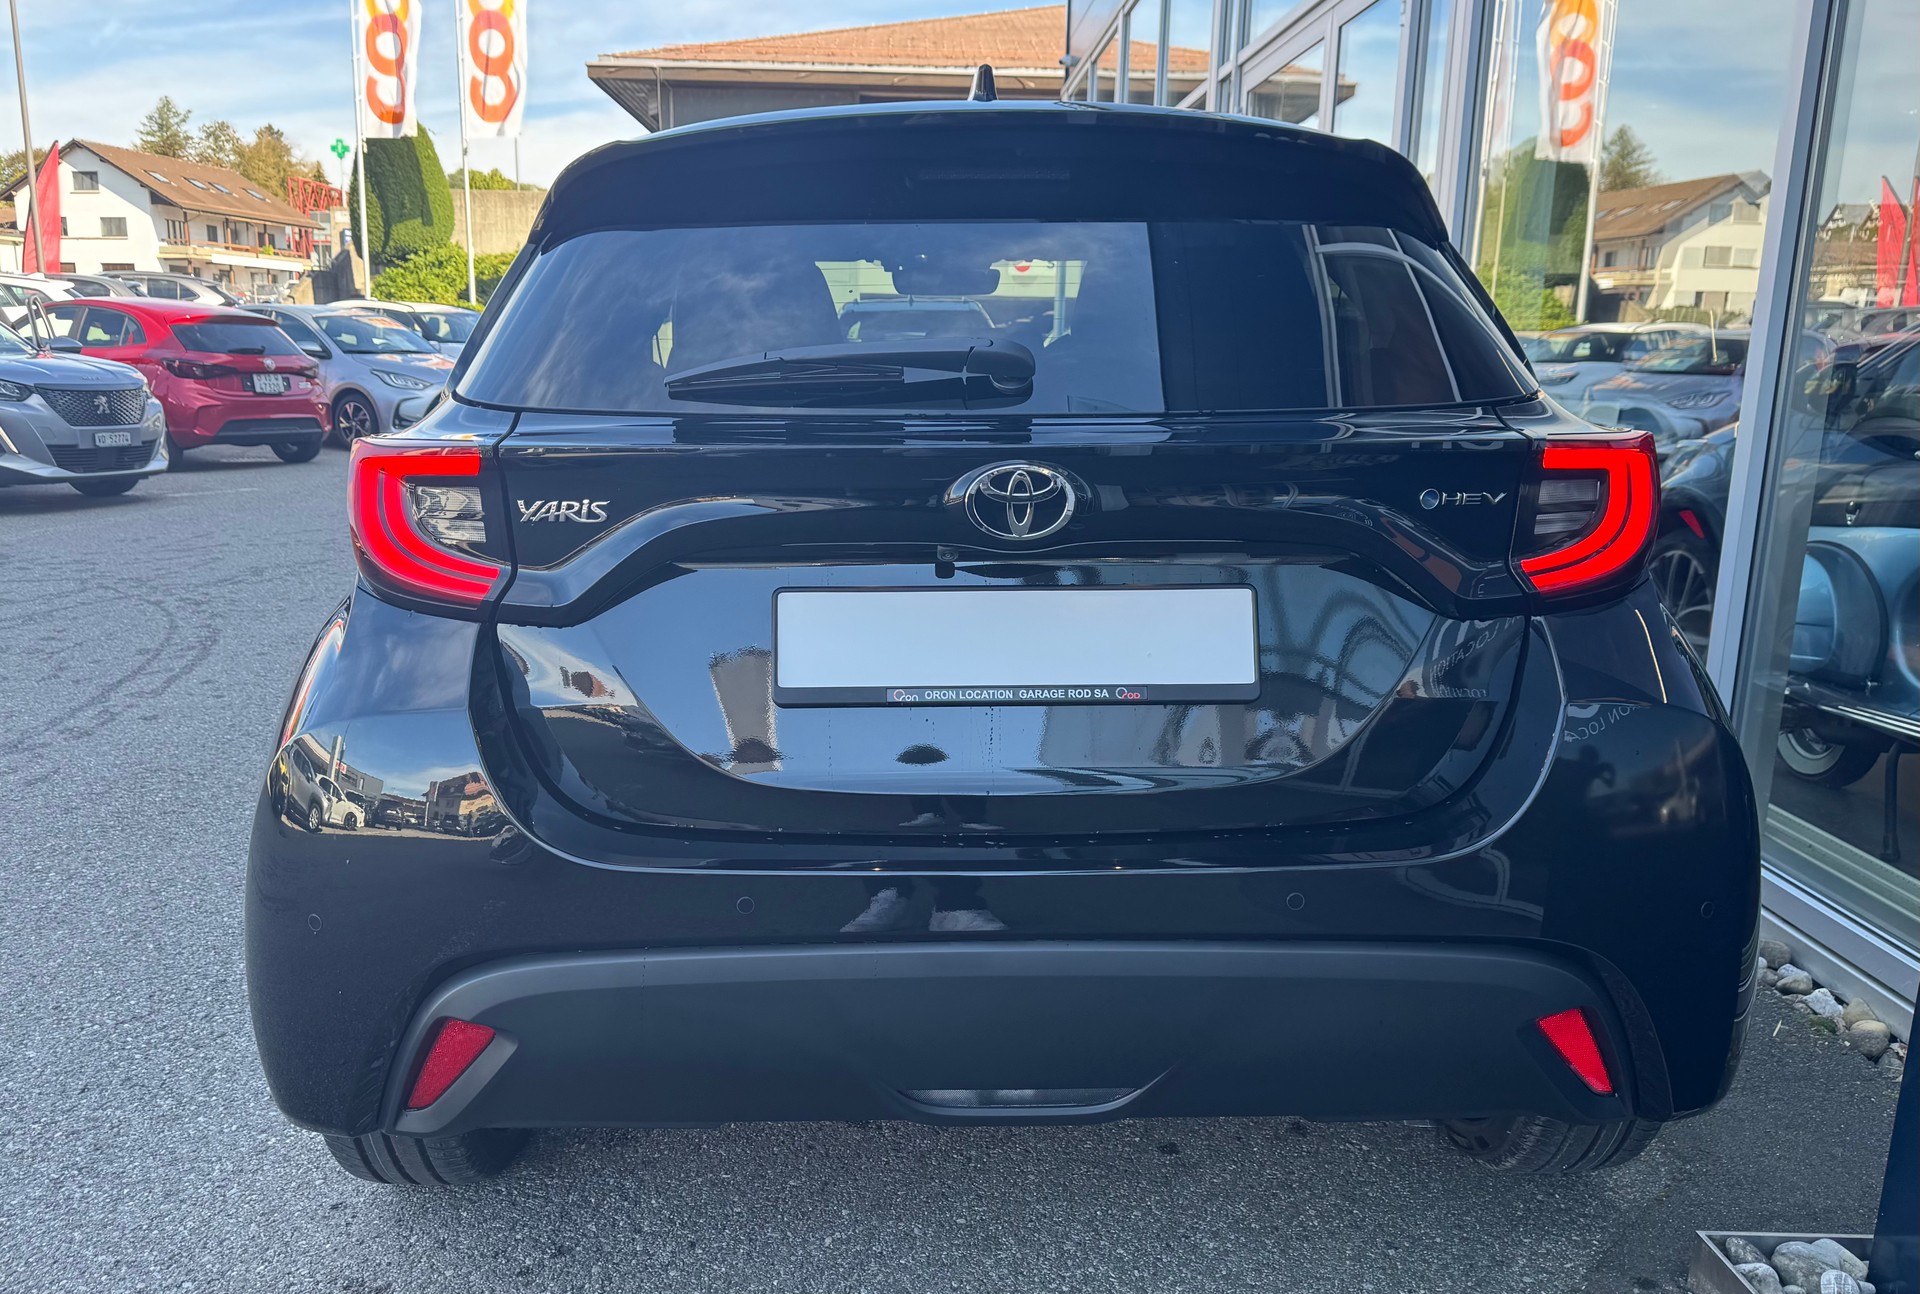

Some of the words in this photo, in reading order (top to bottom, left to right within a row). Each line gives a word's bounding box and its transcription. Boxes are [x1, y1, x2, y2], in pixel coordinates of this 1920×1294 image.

[97, 435, 106, 444] VD
[109, 434, 129, 443] 52774
[1441, 491, 1508, 506] HEV
[924, 690, 956, 700] ORON
[959, 689, 1013, 699] LOCATION
[1018, 689, 1065, 699] GARAGE
[1068, 689, 1092, 698] ROD
[1094, 688, 1109, 698] SA
